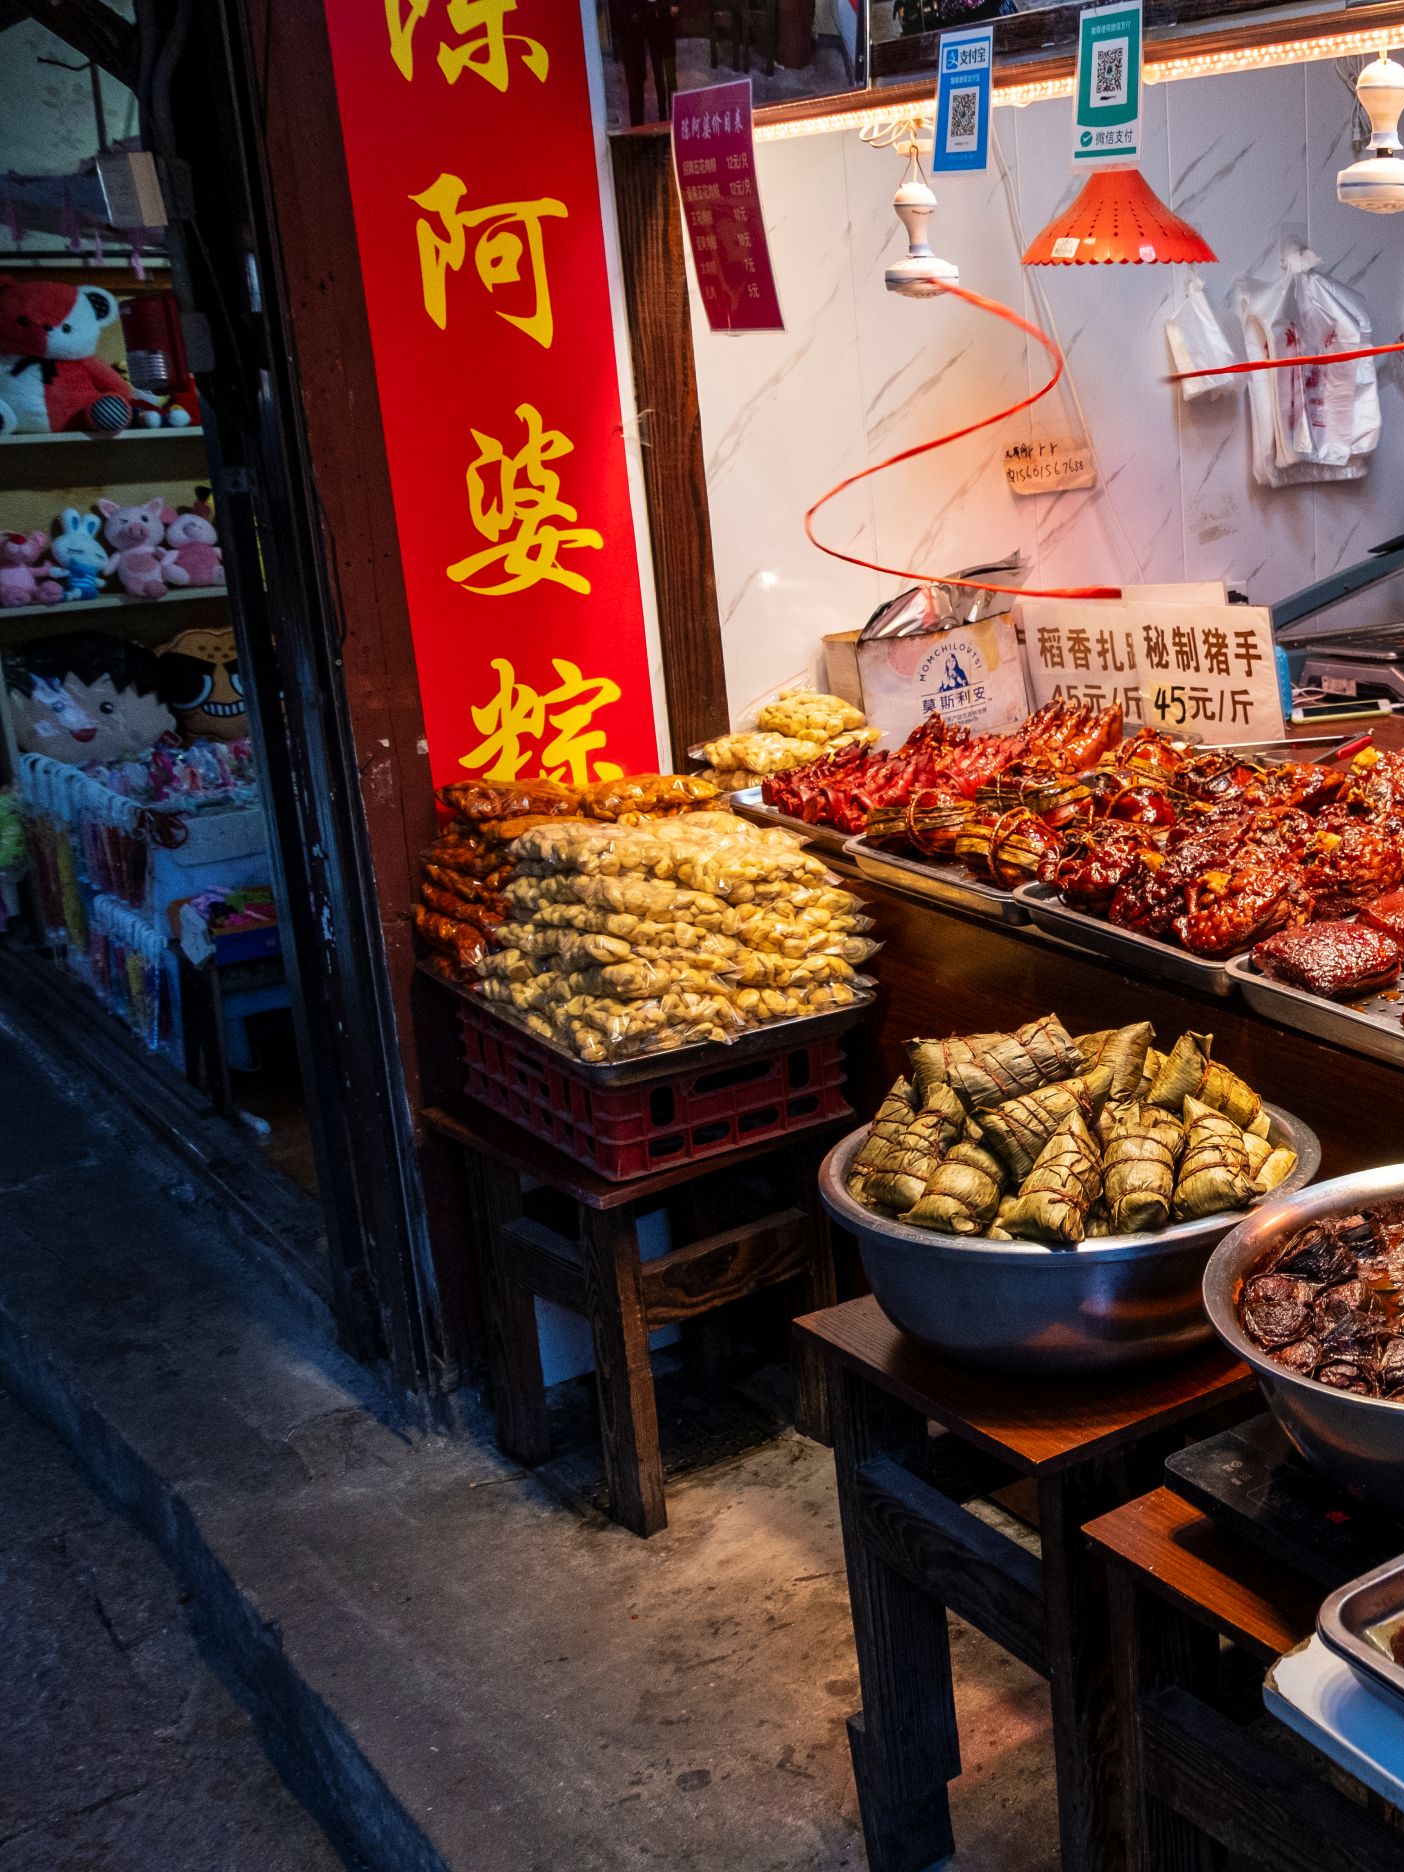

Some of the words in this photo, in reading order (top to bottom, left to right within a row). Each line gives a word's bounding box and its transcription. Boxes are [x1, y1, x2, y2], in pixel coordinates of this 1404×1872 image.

[959, 47, 986, 66] 支付宝
[1095, 129, 1134, 146] 微信支付
[920, 643, 983, 682] MOMCHILOVTSI
[1142, 624, 1262, 678] 秘制猪手
[922, 686, 985, 714] 莫斯利安
[1154, 686, 1254, 725] 45元/斤
